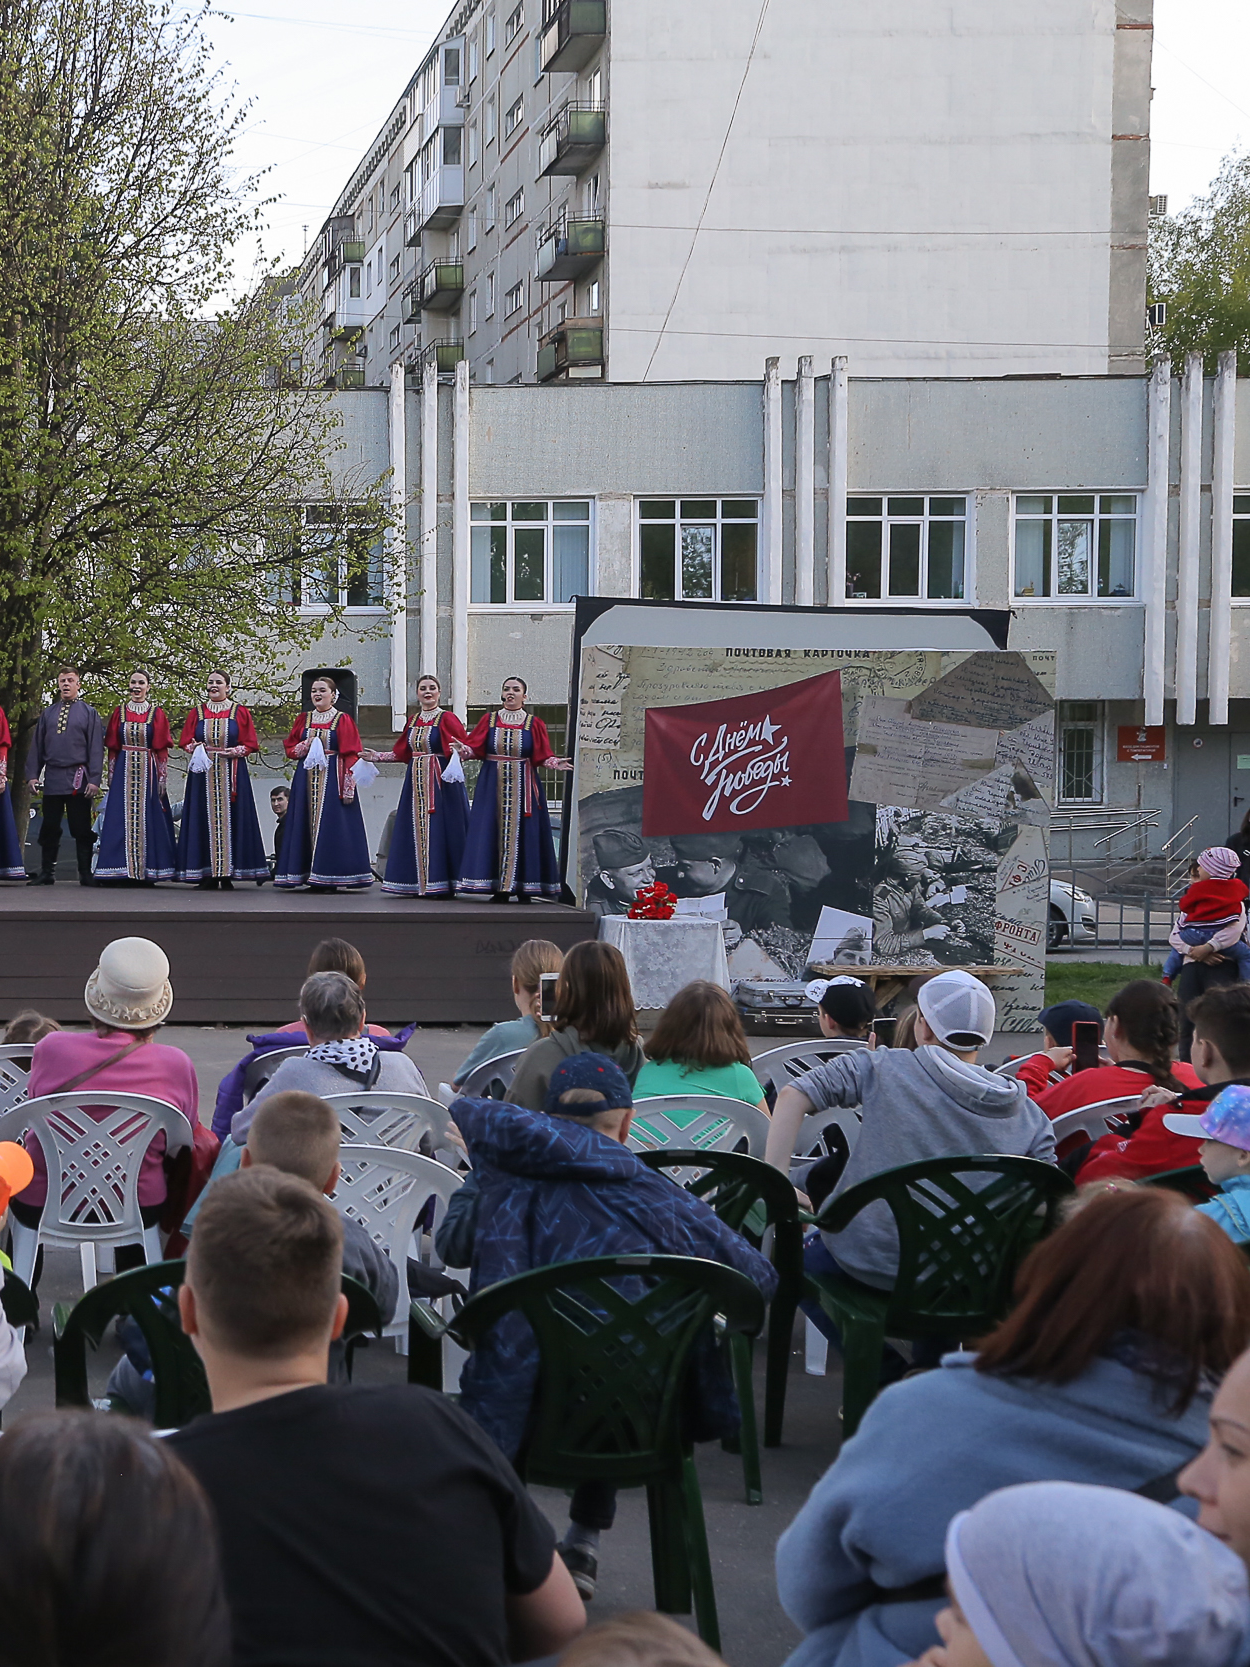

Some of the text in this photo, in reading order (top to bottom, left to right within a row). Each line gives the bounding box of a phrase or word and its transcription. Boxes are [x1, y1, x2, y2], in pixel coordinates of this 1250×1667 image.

[726, 648, 870, 659] ПОЧТОВАЯ КАРТОЧКА
[690, 732, 708, 766] С
[995, 920, 1037, 942] ФРОНТА
